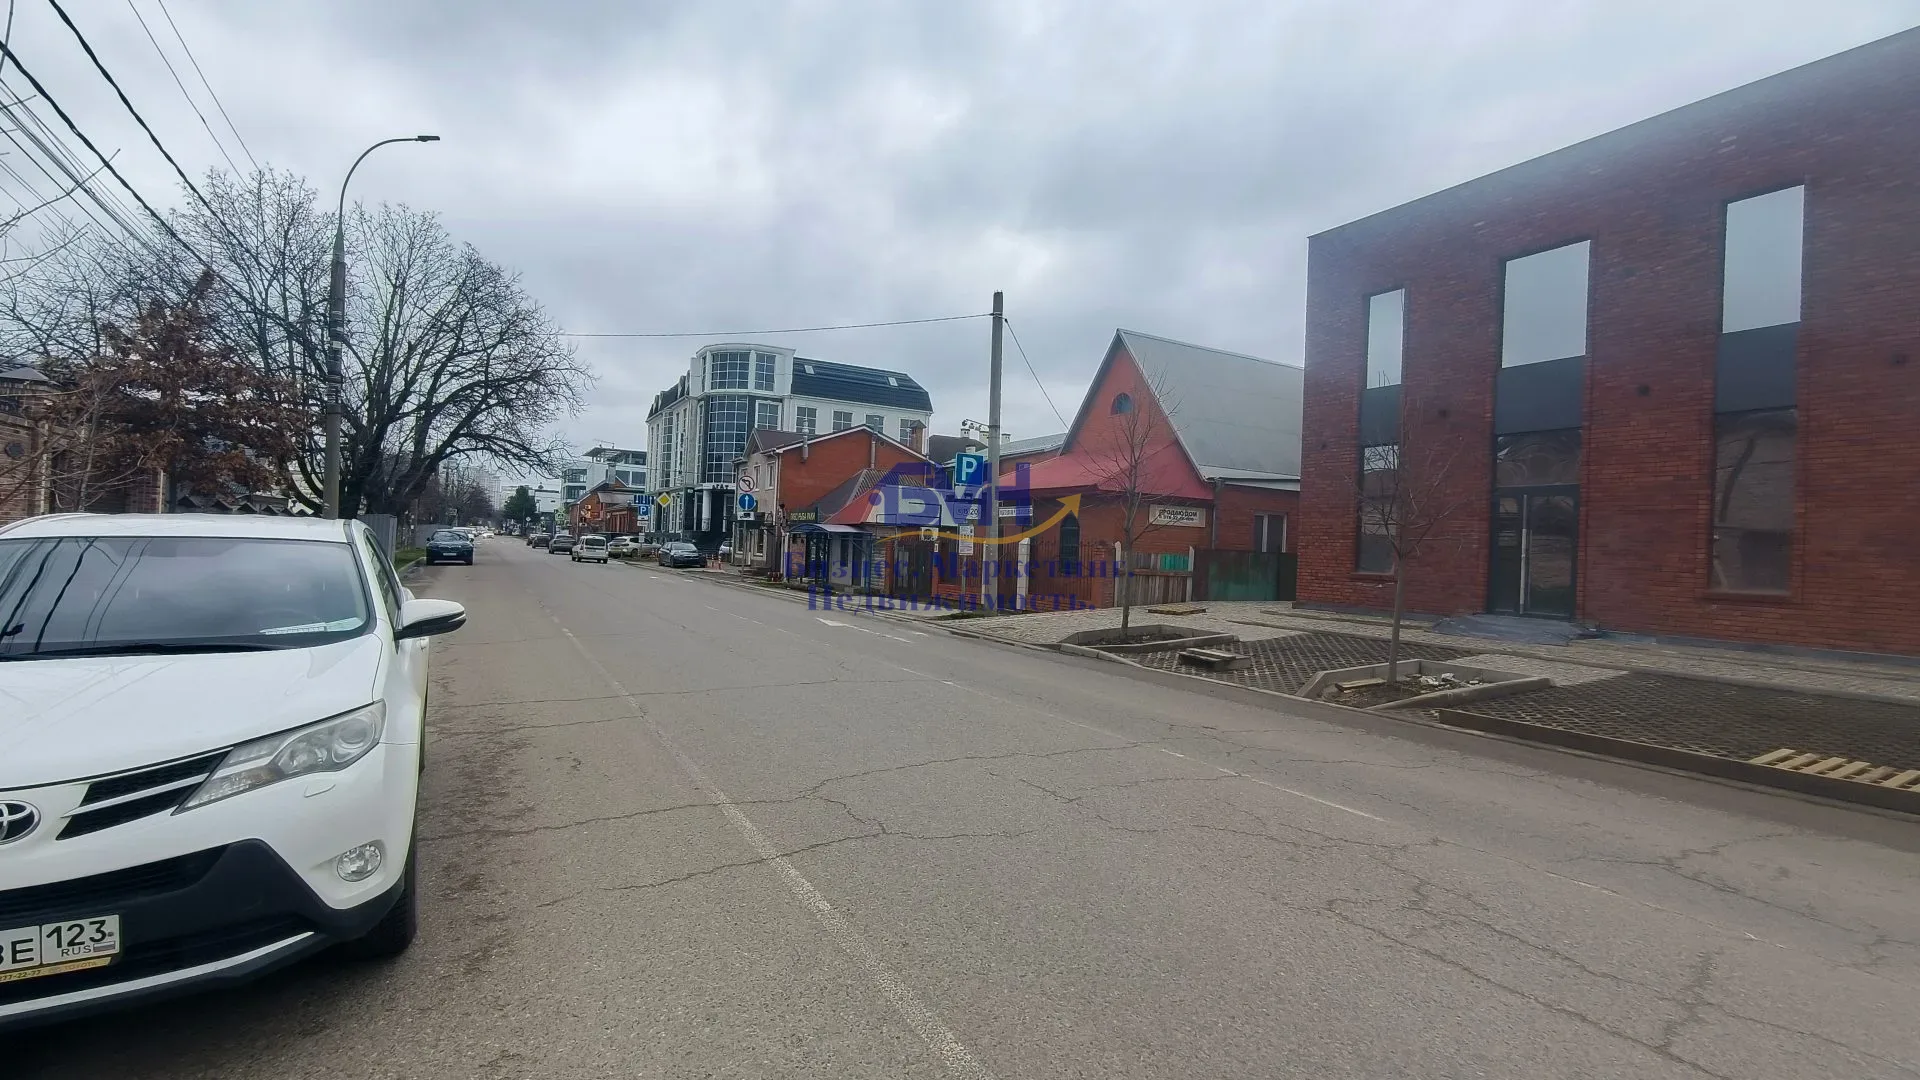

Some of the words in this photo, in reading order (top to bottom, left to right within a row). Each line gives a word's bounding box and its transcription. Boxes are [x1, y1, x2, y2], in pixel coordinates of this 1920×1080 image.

[961, 456, 978, 481] P
[0, 938, 34, 965] E
[46, 919, 107, 949] 123
[61, 945, 92, 957] RUS
